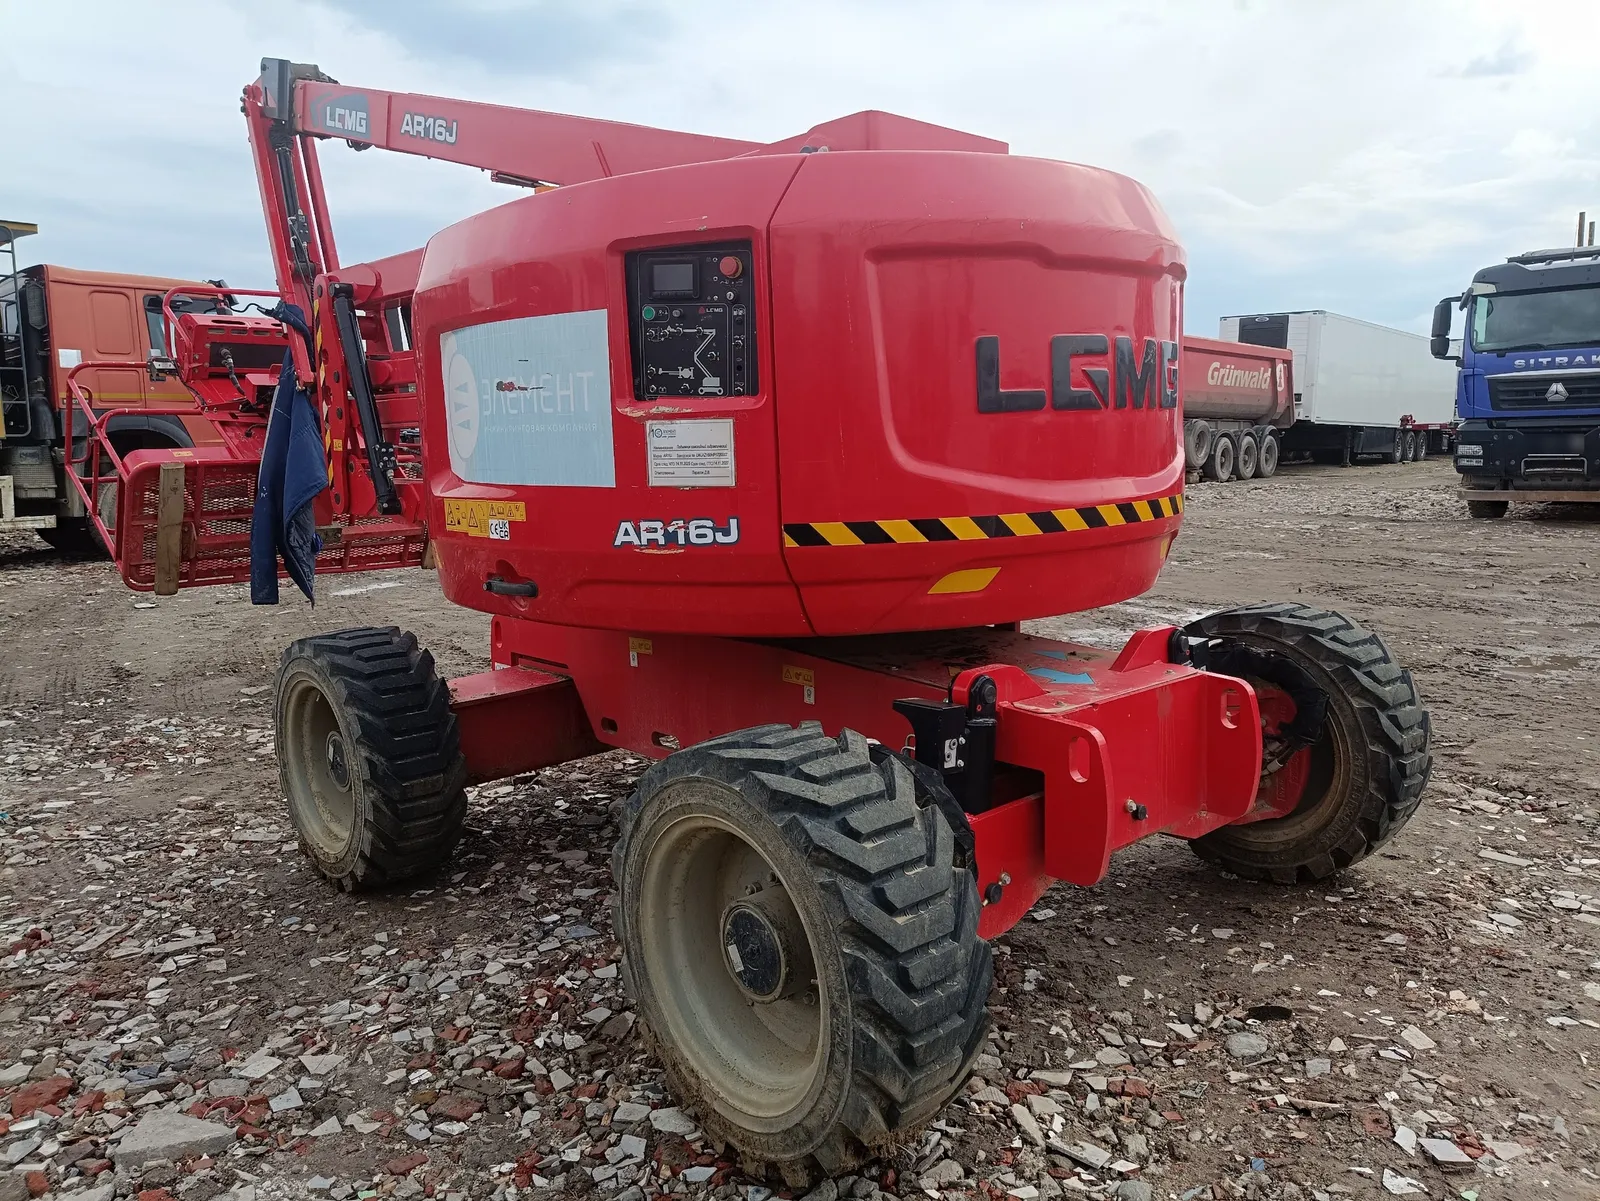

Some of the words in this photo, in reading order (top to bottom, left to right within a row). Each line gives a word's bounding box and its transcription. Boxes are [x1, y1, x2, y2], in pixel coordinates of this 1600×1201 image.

[401, 113, 457, 144] AR16J
[1207, 361, 1271, 390] Grünwald
[481, 371, 594, 416] ЭЛЕМЕНТ
[548, 423, 598, 433] КОМПАНИЯ
[613, 518, 738, 546] AR16J
